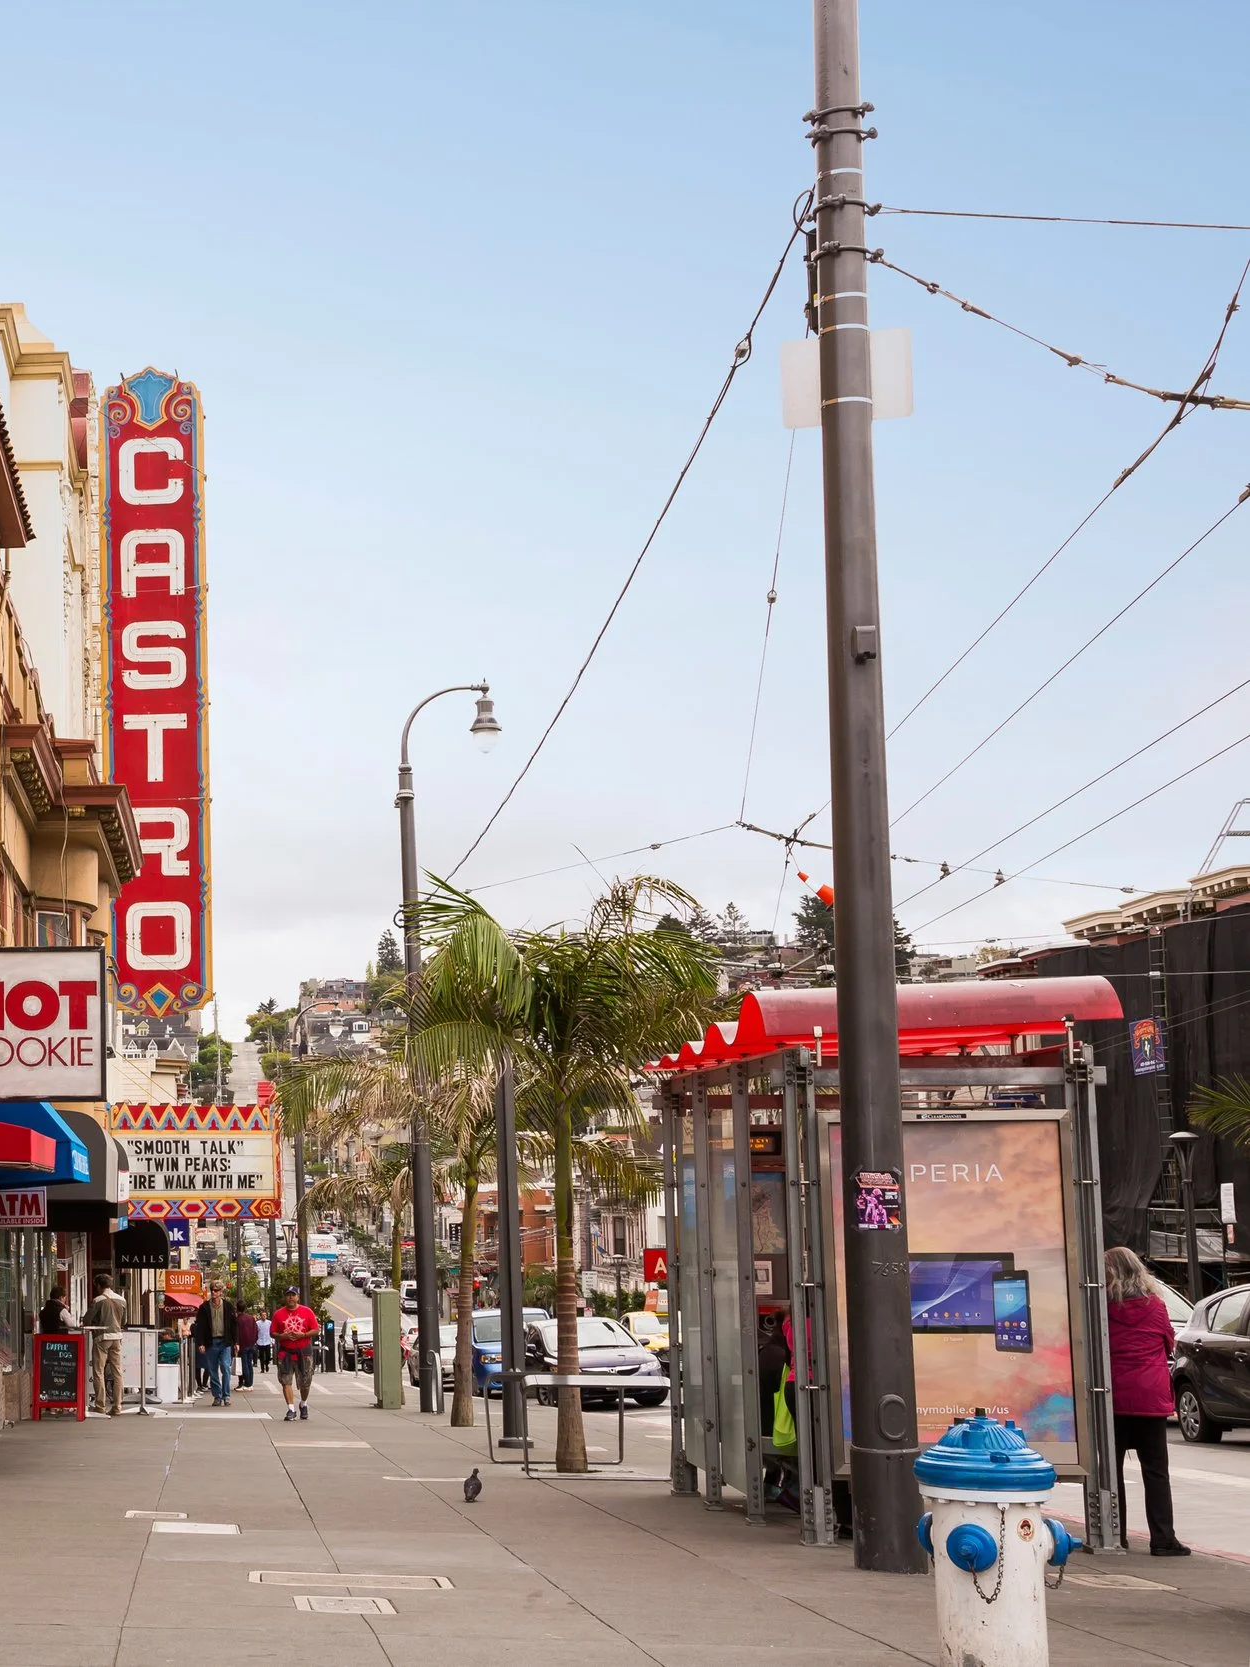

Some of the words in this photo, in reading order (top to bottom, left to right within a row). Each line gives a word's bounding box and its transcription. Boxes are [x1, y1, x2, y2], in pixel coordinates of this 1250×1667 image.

[118, 437, 192, 971] CASTRO
[127, 1140, 190, 1155] "SMOOTH
[200, 1140, 244, 1155] TALK"
[137, 1157, 179, 1172] "TWIN
[185, 1157, 231, 1172] PEAKS:
[909, 1163, 1004, 1182] PERIA
[164, 1174, 196, 1189] WALK
[202, 1174, 233, 1189] WITH
[237, 1174, 263, 1189] ME"
[121, 1254, 164, 1263] NAILS
[169, 1275, 196, 1285] SLURP
